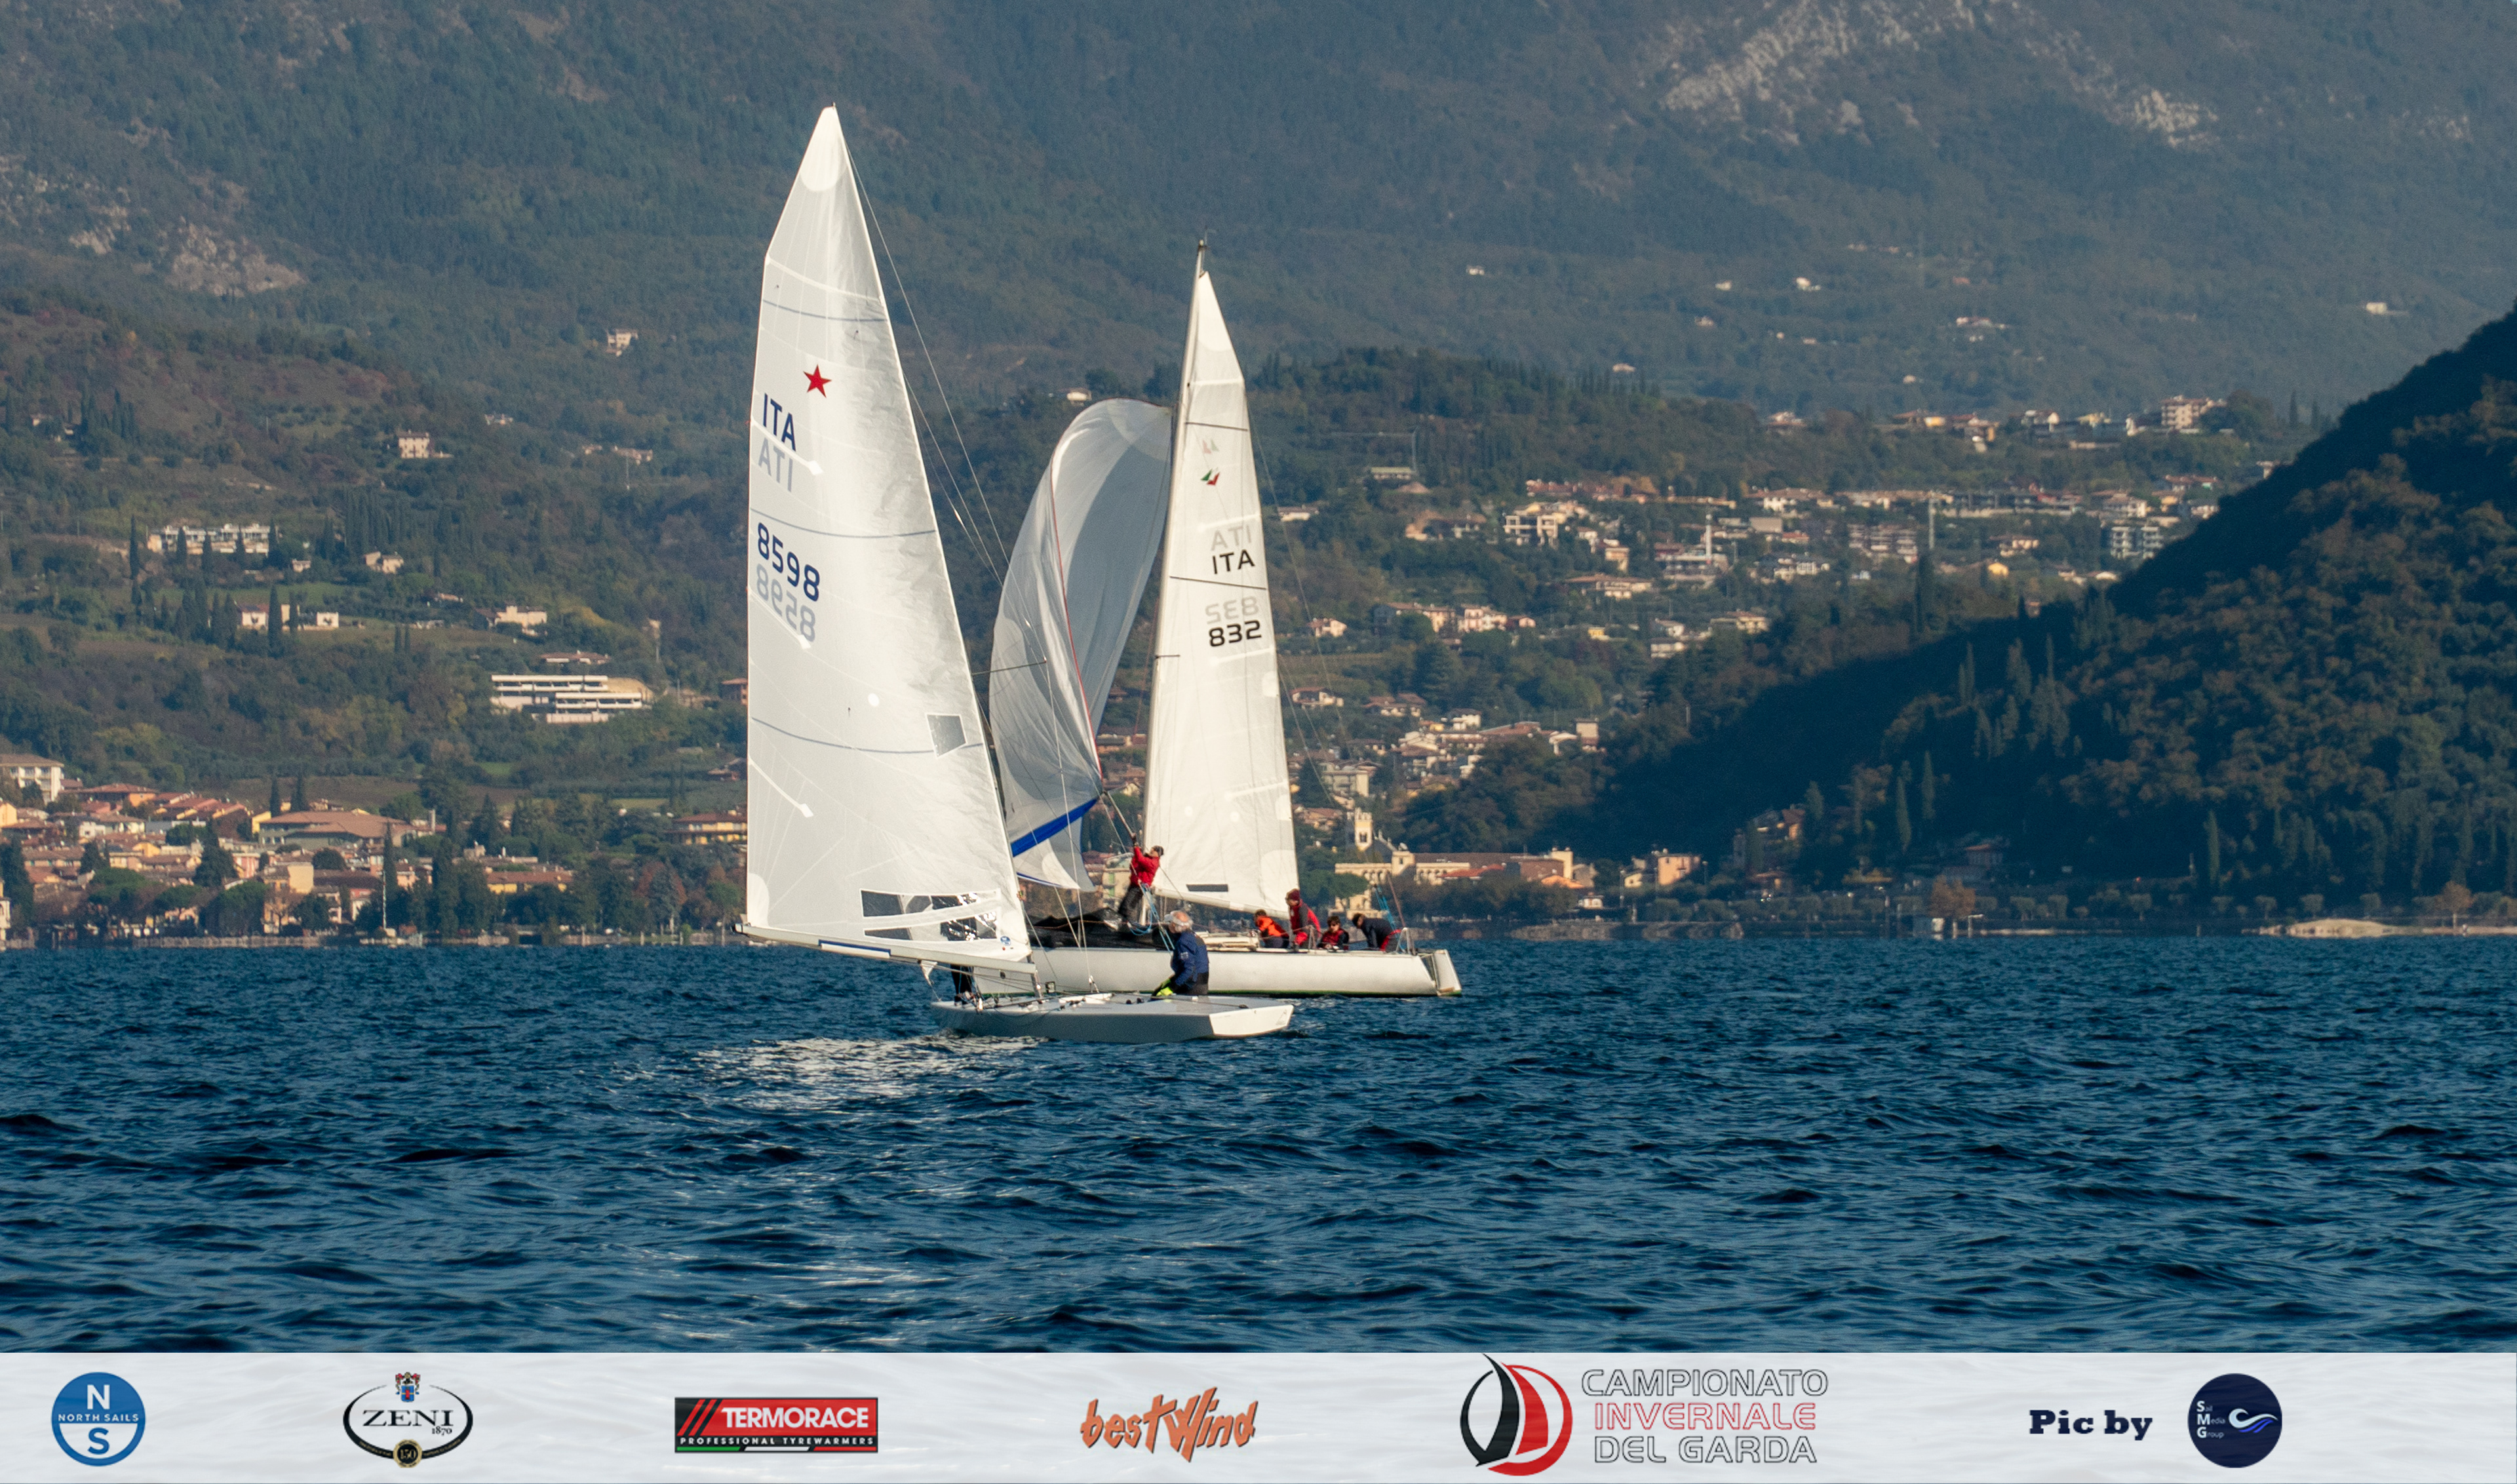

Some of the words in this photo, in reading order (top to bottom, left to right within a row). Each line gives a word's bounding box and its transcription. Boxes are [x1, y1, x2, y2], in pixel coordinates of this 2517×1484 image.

[762, 393, 797, 452] ITA
[757, 522, 821, 602] 8598
[1212, 549, 1255, 575] ITA
[1208, 619, 1262, 648] 832
